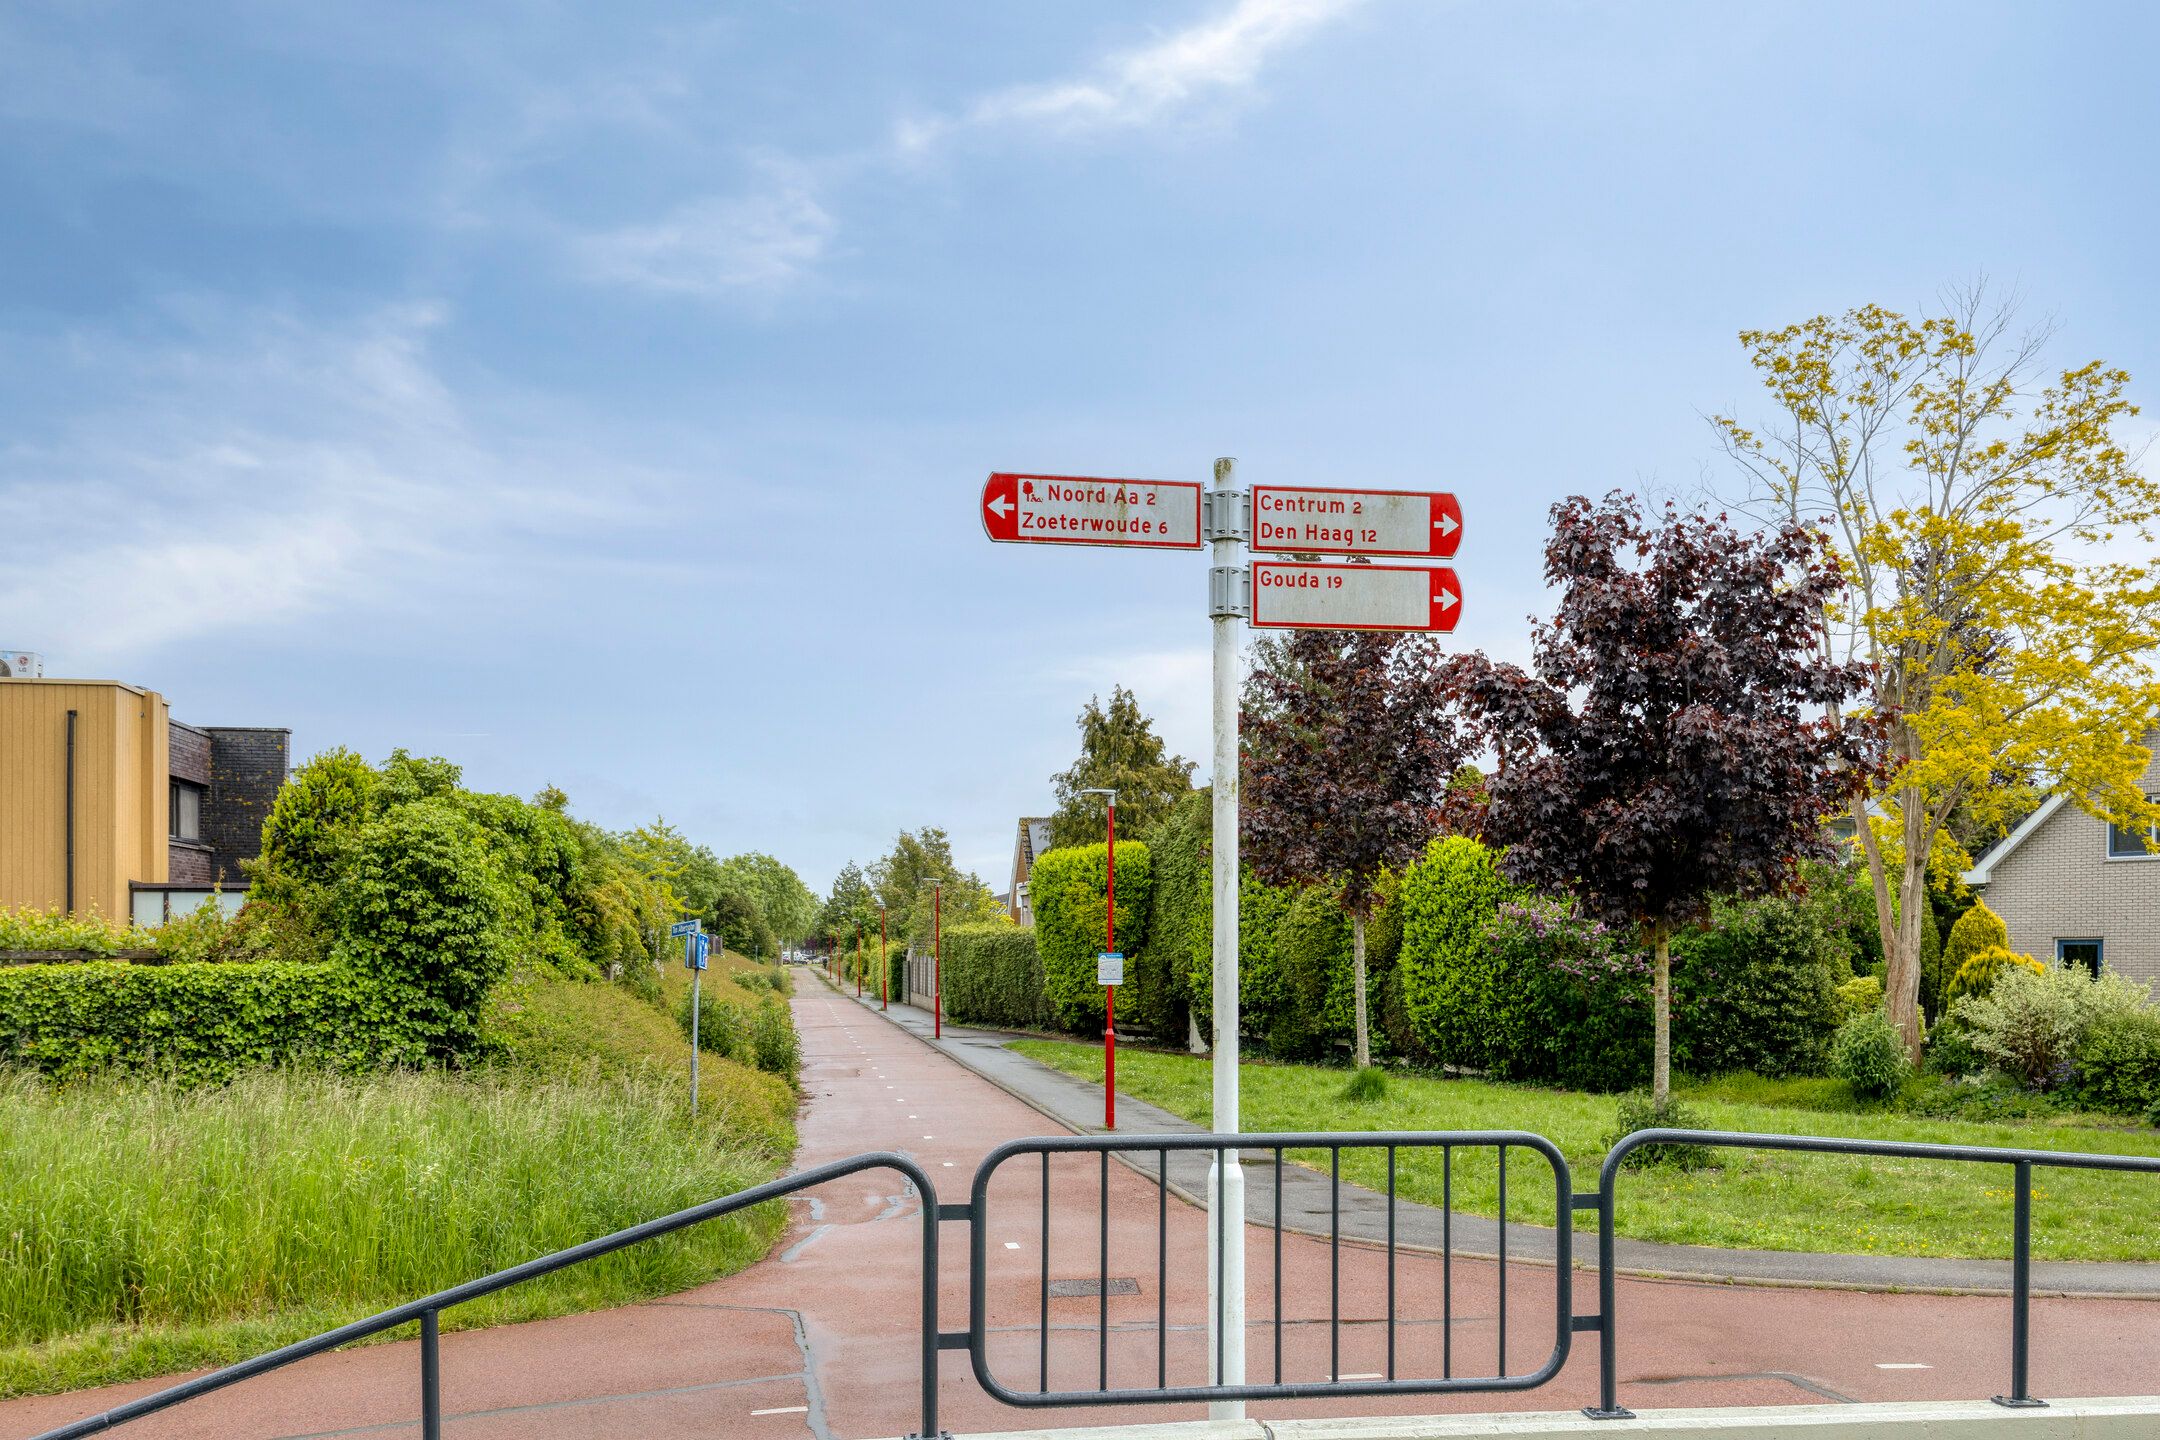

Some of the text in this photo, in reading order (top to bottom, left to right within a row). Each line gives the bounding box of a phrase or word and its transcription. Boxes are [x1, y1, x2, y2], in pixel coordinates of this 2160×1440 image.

[1048, 484, 1157, 506] Noord Aa 2
[1260, 494, 1362, 515] Centrum 2
[1022, 511, 1168, 534] Zoeterwoude 6
[1260, 522, 1377, 547] Den Haag 12
[1260, 570, 1343, 589] Gouda 19
